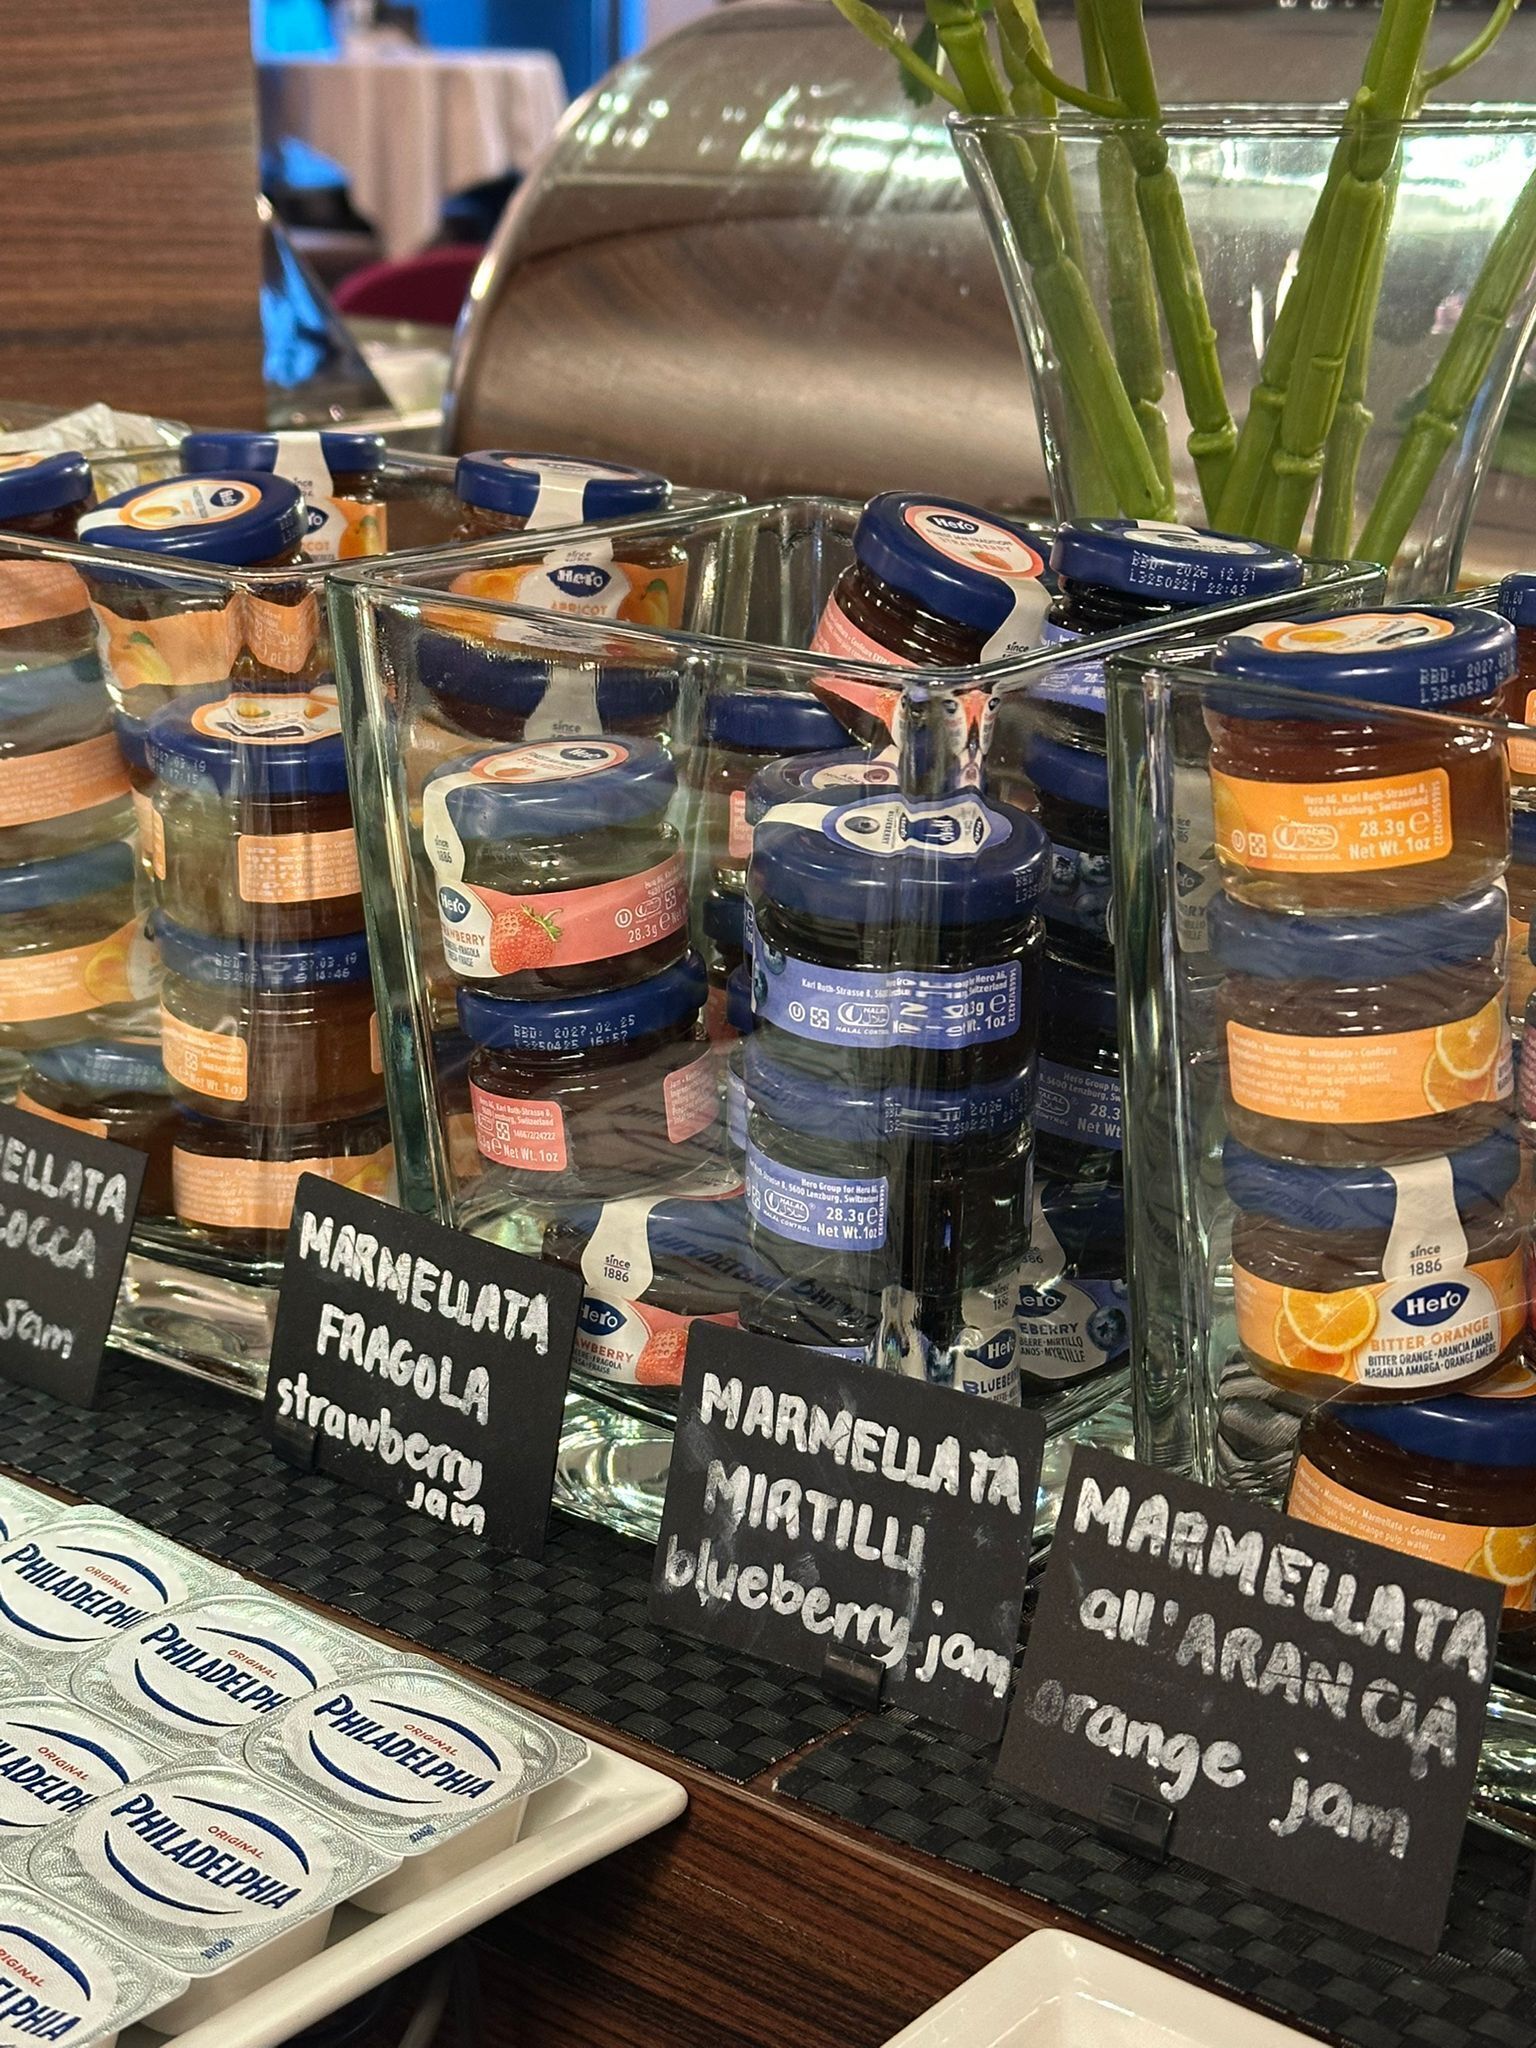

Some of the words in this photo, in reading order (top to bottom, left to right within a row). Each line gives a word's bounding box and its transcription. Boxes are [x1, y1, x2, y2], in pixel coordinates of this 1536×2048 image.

[932, 516, 975, 531] Hero
[557, 569, 604, 588] Hero
[1206, 582, 1248, 597] 22:43
[1005, 642, 1030, 653] since
[1359, 819, 1406, 838] 28.3g
[1348, 843, 1376, 860] Net
[1378, 842, 1404, 858] Wt.
[1406, 836, 1431, 851] 1oz
[440, 892, 466, 915] Hero
[627, 924, 658, 944] 28.3g
[801, 978, 816, 989] Karl
[513, 1025, 543, 1038] BBD:
[553, 1014, 636, 1039] 2027.02.25
[984, 1015, 1007, 1031] 1oz
[1089, 1103, 1120, 1121] 28.3
[1077, 1117, 1100, 1135] Net
[503, 1144, 519, 1159] Net
[520, 1147, 537, 1161] Wt.
[539, 1150, 559, 1162] 1oz
[0, 1135, 128, 1224] ELLATA
[801, 1178, 817, 1189] Hero
[818, 1182, 841, 1195] Group
[806, 1189, 843, 1204] Lenzburg,
[826, 1206, 864, 1226] 28.3g
[817, 1222, 839, 1238] Net
[842, 1225, 862, 1240] Wt.
[863, 1226, 878, 1239] 1oz
[603, 1254, 631, 1268] since
[1409, 1244, 1441, 1258] since
[603, 1266, 630, 1283] 1886
[1409, 1260, 1443, 1278] 1886
[299, 1211, 549, 1356] MARMELLATA
[1406, 1290, 1461, 1316] Hero
[1019, 1322, 1079, 1336] EBERRY
[1370, 1334, 1425, 1352] BITTER
[1430, 1316, 1490, 1346] ORANGE
[575, 1338, 635, 1364] AWBERRY
[1367, 1355, 1398, 1367] BITTER
[1399, 1349, 1433, 1365] ORANGE
[1438, 1343, 1470, 1359] ARANCIA
[317, 1303, 490, 1426] FRAGOLA
[1364, 1367, 1404, 1379] NARANJA
[1405, 1361, 1441, 1376] AMARGA
[1444, 1354, 1474, 1370] ORANGE
[277, 1372, 483, 1501] strawberry
[85, 1565, 133, 1596] ORIGINAL
[1073, 1477, 1489, 1684] MARMELLATA
[665, 1533, 911, 1669] blueberry
[914, 1599, 1012, 1699] jam
[140, 1622, 293, 1714] PHILADELPH
[227, 1649, 279, 1680] ORIGINAL
[313, 1693, 496, 1800] PHILADELPHIA
[404, 1723, 459, 1757] ORIGINAL
[38, 1746, 89, 1781] ORIGINAL
[1024, 1678, 1247, 1802] orange
[1268, 1747, 1411, 1860] jam
[110, 1792, 302, 1910] PHILADELPHIA
[207, 1825, 265, 1860] ORIGINAL
